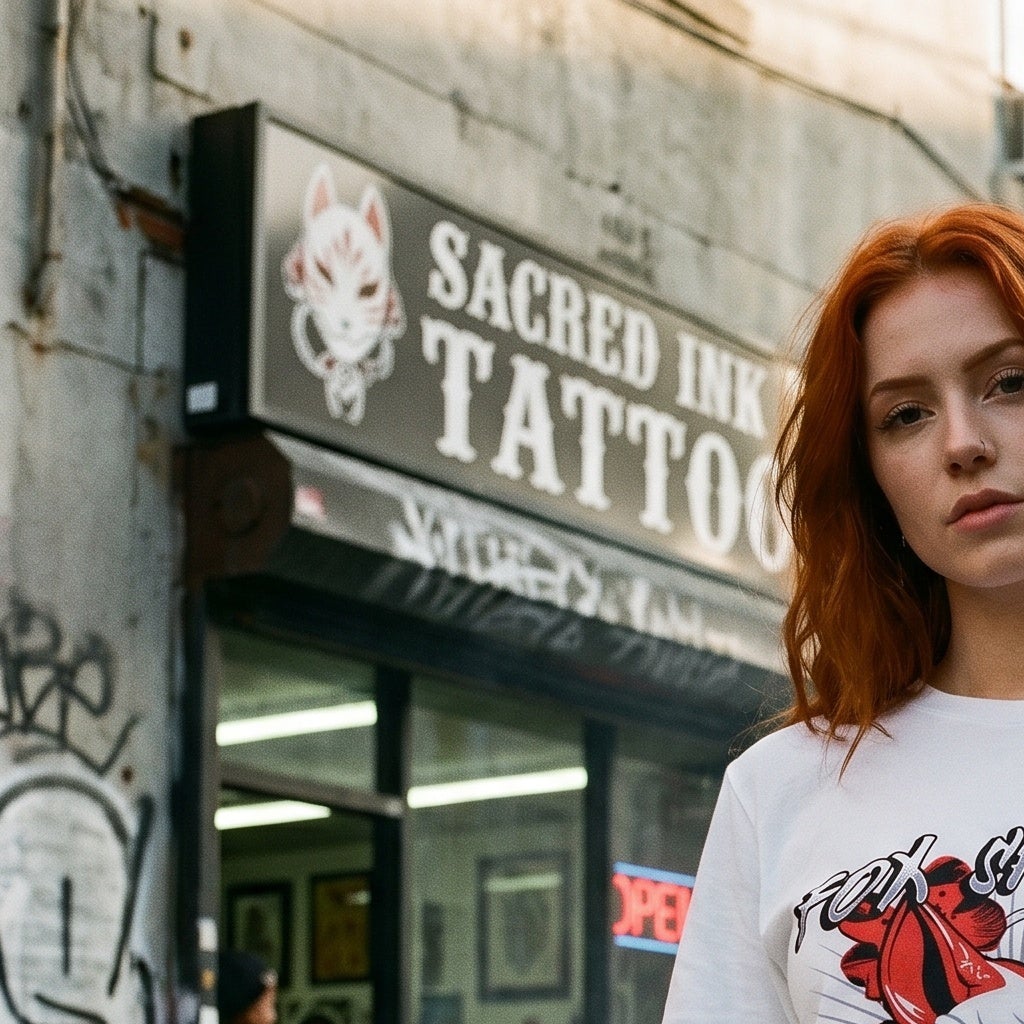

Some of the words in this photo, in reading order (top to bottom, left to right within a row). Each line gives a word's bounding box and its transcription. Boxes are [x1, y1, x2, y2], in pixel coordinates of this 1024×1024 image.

[420, 315, 797, 575] TATTOO
[428, 219, 661, 392] SACRED
[676, 332, 769, 439] INK
